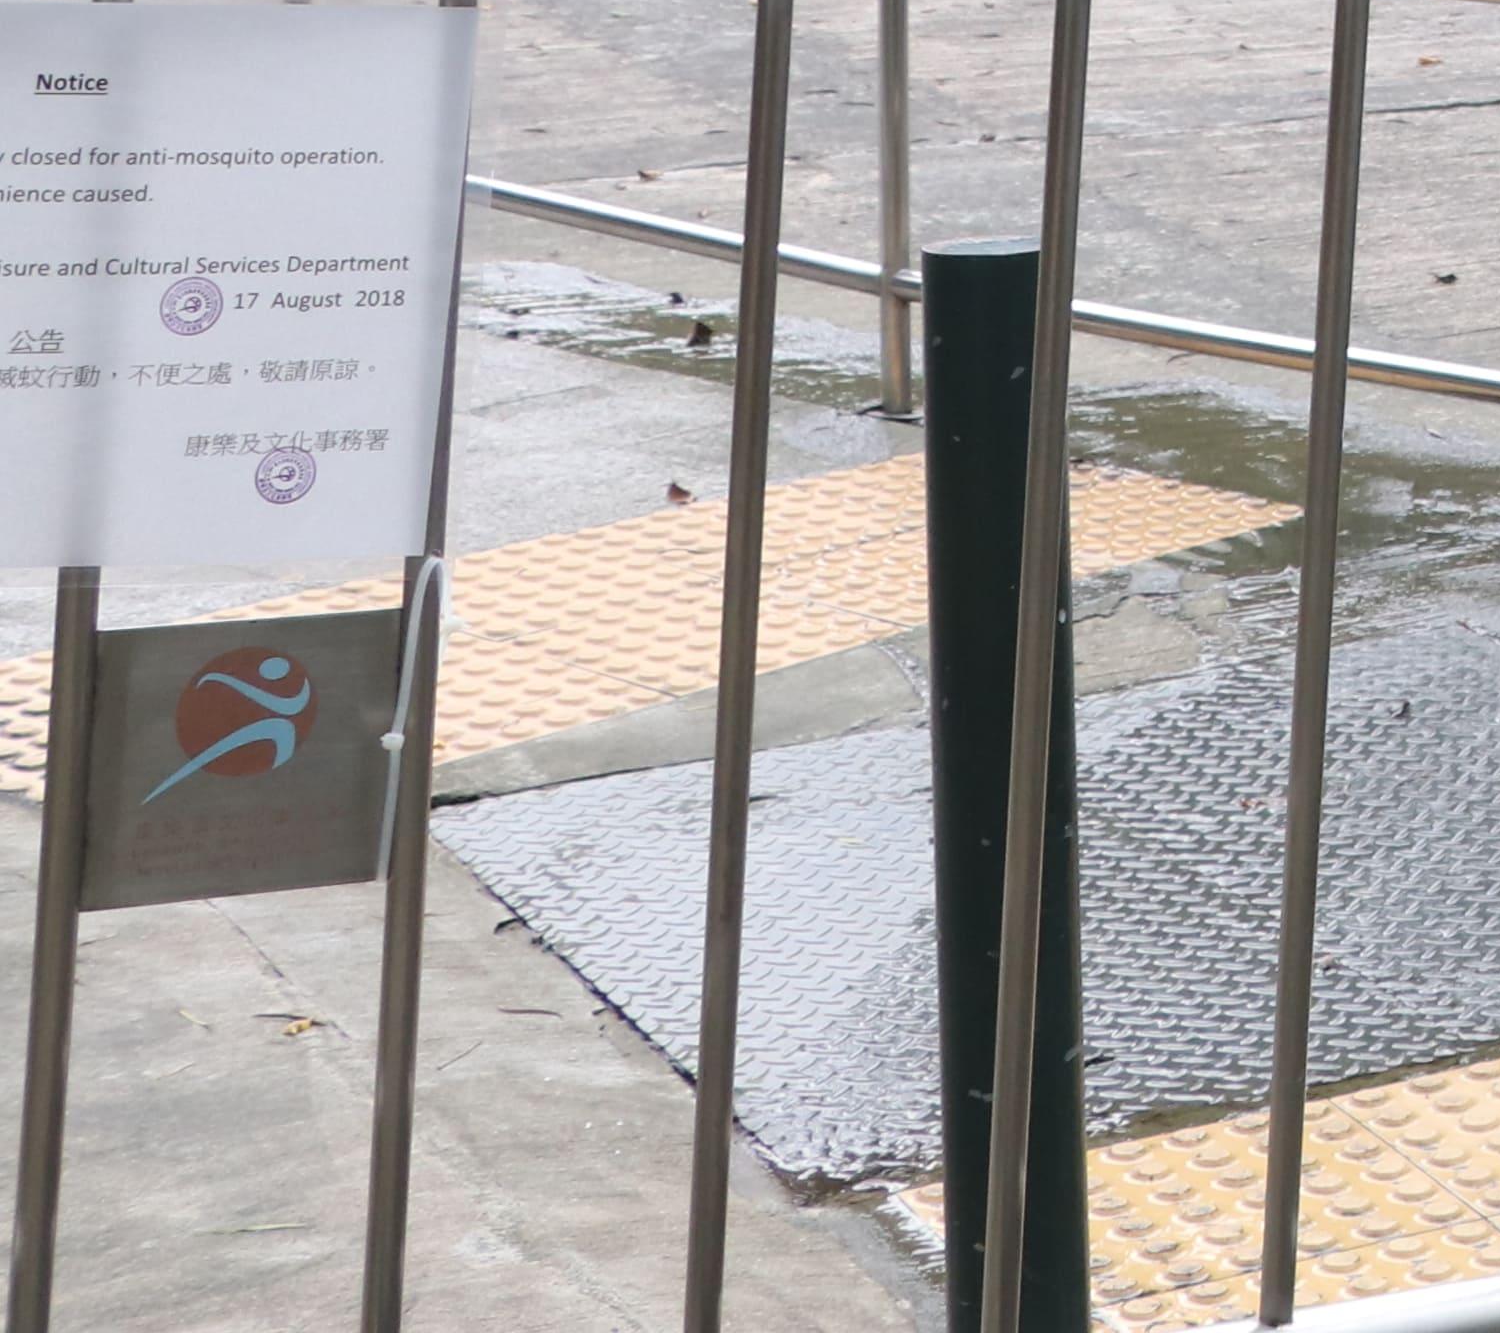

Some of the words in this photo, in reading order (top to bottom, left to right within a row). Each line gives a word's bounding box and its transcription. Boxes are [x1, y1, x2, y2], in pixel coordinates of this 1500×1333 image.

[35, 72, 109, 95] Notice
[11, 146, 82, 166] closed
[89, 146, 120, 166] for
[126, 147, 275, 169] anti-mosquito
[280, 147, 385, 169] operation.
[72, 184, 153, 203] caused.
[57, 258, 99, 277] and
[105, 257, 189, 276] Cultural
[195, 257, 281, 274] Services
[287, 255, 410, 276] Department
[233, 292, 260, 310] 17
[271, 292, 343, 313] August
[355, 289, 406, 308] 2018
[8, 328, 65, 354] 公告
[184, 428, 390, 457] 康樂及文化事務署
